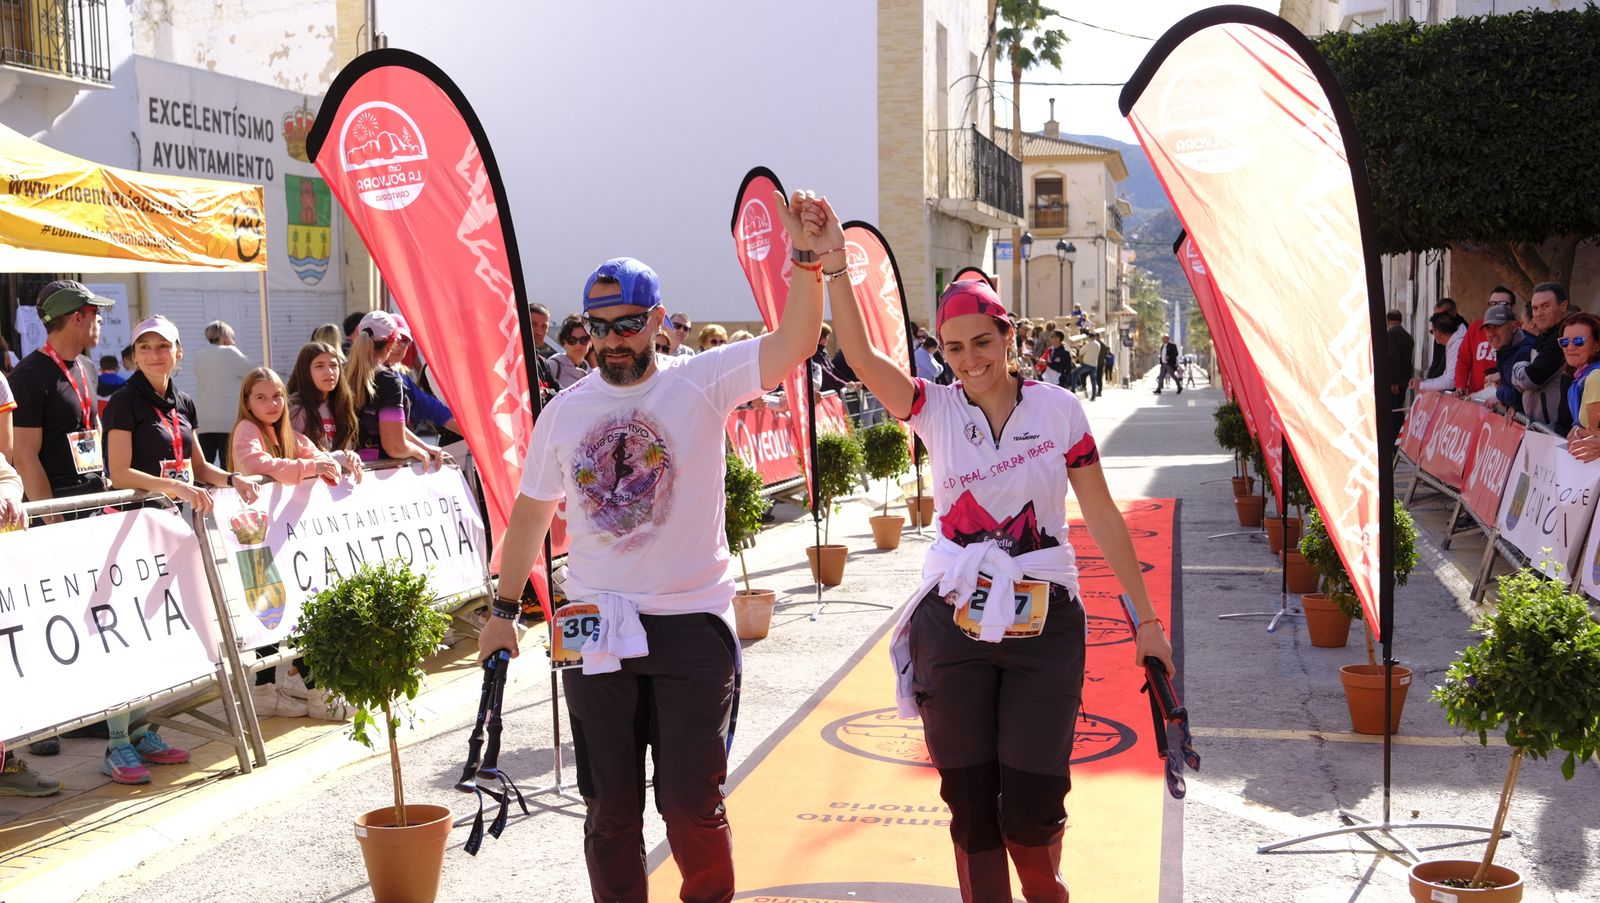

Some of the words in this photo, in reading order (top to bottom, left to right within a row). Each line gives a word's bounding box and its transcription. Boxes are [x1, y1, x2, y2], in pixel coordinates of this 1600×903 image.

[149, 97, 274, 143] EXCELENTÍSIMO
[153, 141, 274, 181] AYUNTAMIENTO
[943, 477, 956, 489] CD
[959, 468, 987, 489] PEAL
[990, 454, 1025, 477] SIERRA
[286, 501, 432, 541] AYUNTAMIENTO
[438, 496, 462, 514] DE
[293, 520, 474, 592] CANTORIA
[0, 564, 123, 613] MIENTO
[136, 554, 169, 581] DE
[970, 589, 1028, 615] 27
[0, 589, 191, 678] TORIA
